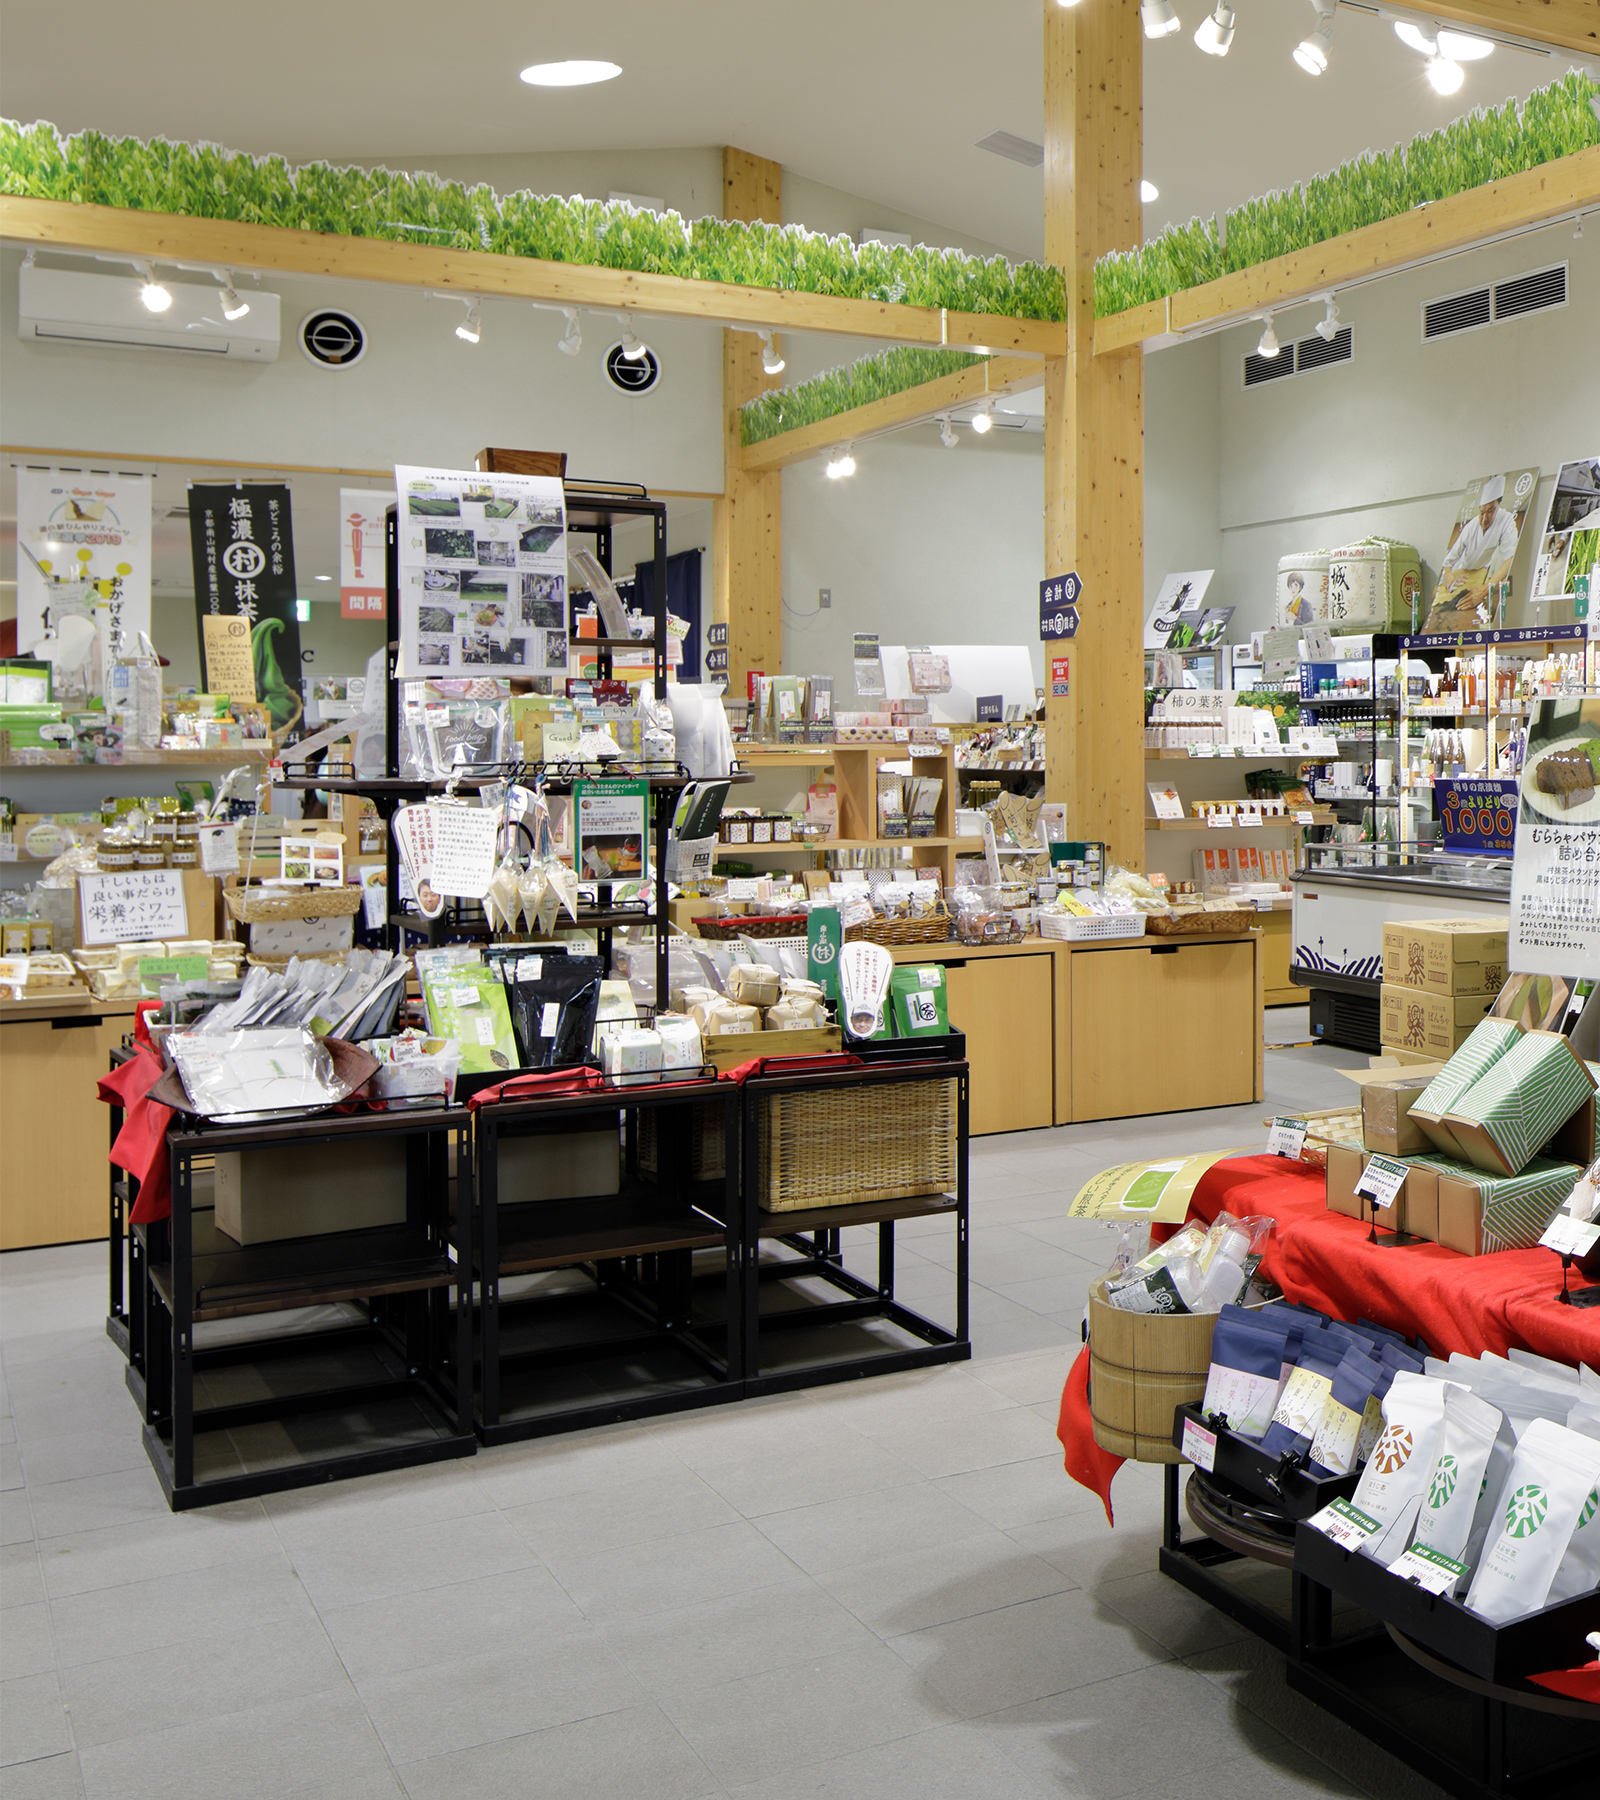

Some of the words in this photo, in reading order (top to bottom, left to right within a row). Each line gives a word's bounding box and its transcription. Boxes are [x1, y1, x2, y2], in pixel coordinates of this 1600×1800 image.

[229, 498, 254, 541] 極濃
[268, 499, 284, 576] 茶どころの余裕
[234, 580, 259, 622] 抹茶
[1045, 584, 1062, 603] 会計
[349, 596, 383, 611] 間隔
[1171, 694, 1224, 709] 柿の葉茶
[96, 874, 166, 888] 干しいもは
[93, 886, 176, 903] 良い事だらけ
[88, 902, 181, 920] 栄養パワー
